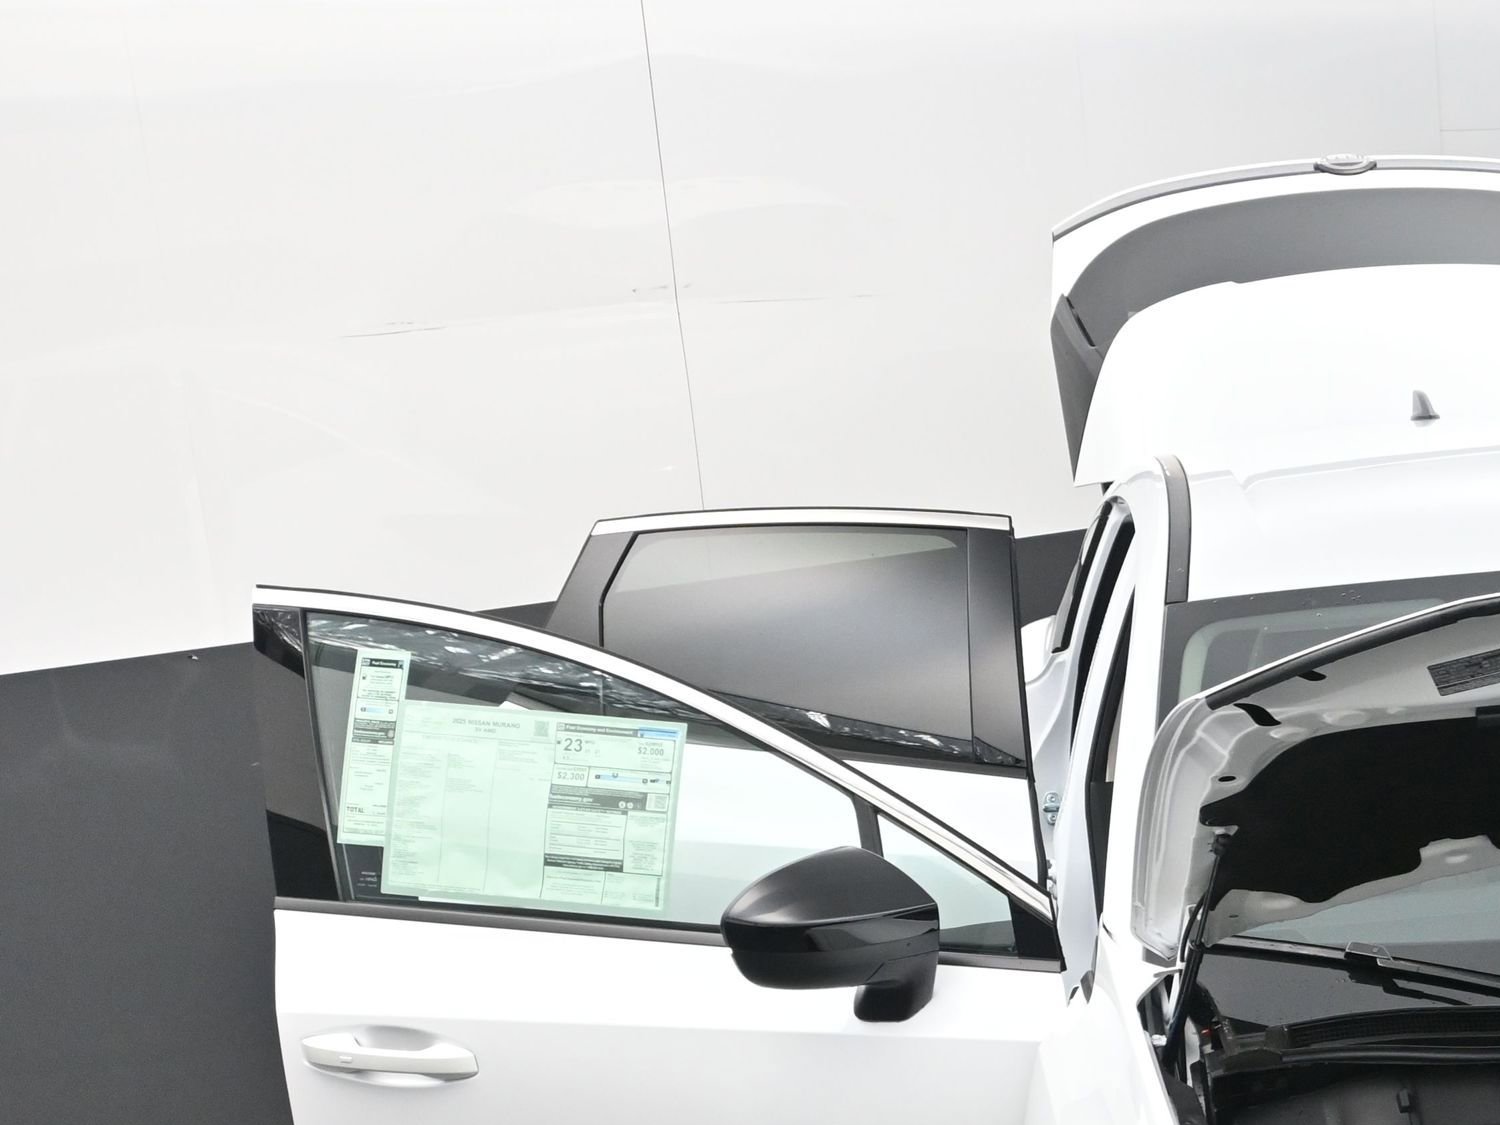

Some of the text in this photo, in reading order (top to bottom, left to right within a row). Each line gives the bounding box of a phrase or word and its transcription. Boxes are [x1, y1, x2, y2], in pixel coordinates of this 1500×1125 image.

[468, 719, 491, 727] NISSAN
[492, 721, 521, 729] MURANO
[564, 738, 583, 752] 23
[638, 747, 664, 756] $2,000
[346, 805, 365, 814] TOTAL
